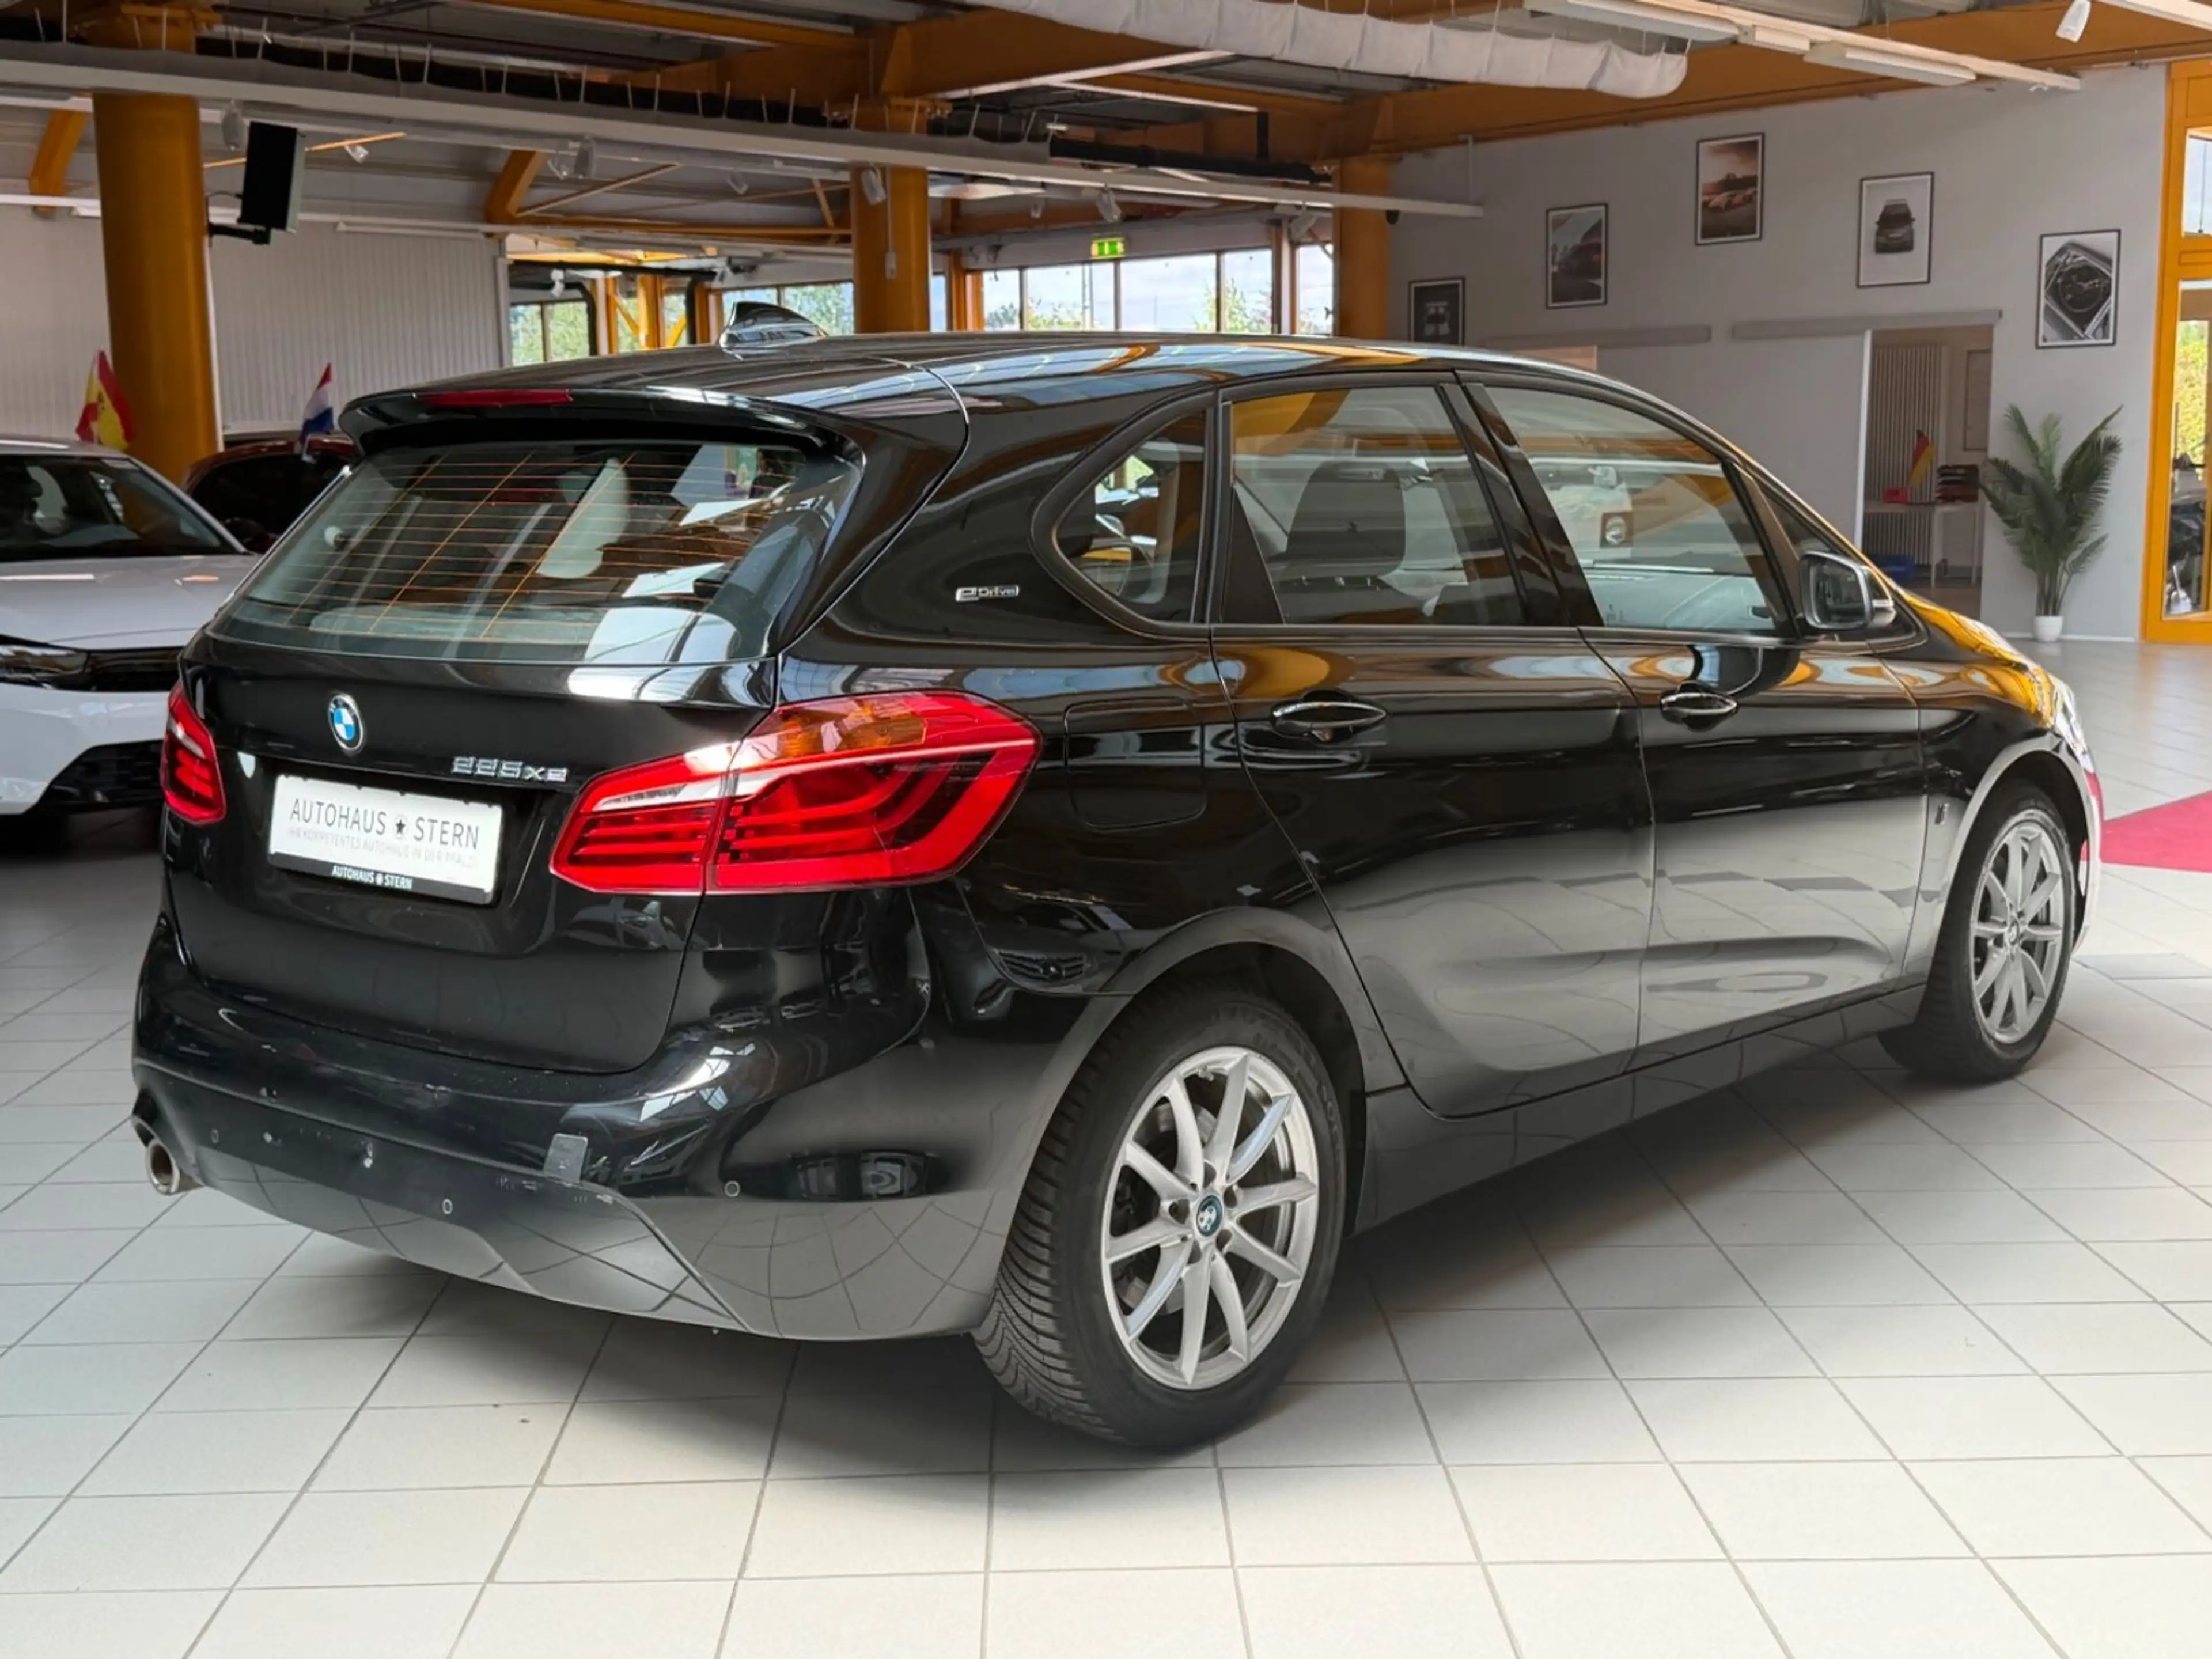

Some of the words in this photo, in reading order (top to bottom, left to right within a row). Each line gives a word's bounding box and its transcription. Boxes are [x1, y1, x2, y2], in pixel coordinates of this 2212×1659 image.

[290, 798, 387, 835] AUTOHAUS
[414, 817, 479, 849] STERN
[332, 865, 374, 884] AUTOHAUS
[385, 874, 413, 891] STERN
